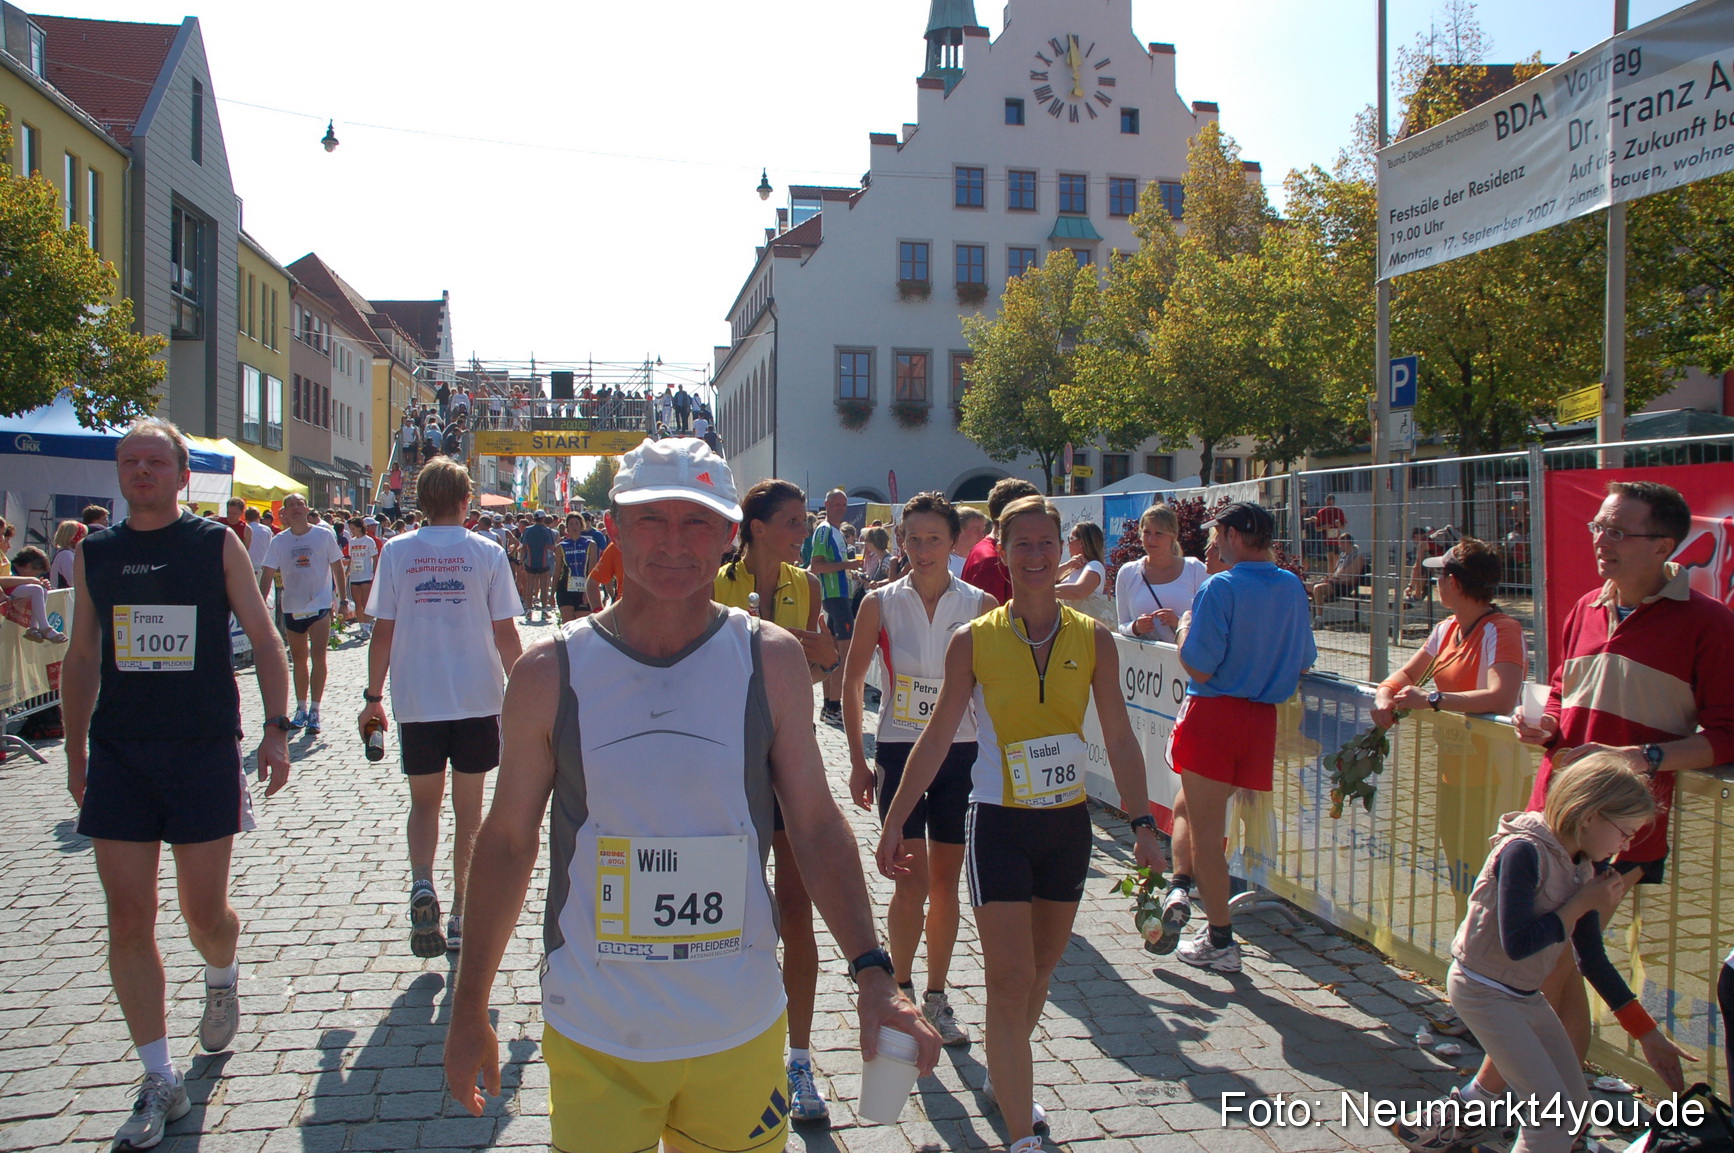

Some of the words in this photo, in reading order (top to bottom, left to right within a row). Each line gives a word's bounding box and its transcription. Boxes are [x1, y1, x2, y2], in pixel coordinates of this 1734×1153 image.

[1035, 51, 1053, 67] X
[1094, 58, 1111, 70] II
[1564, 46, 1642, 97] Vortrag
[1085, 102, 1098, 119] V
[1568, 117, 1599, 152] Dr.
[1607, 80, 1695, 133] Franz
[1704, 59, 1734, 101] A
[1387, 153, 1406, 169] Bund
[1408, 138, 1444, 162] Deutscher
[1446, 119, 1489, 146] Architekten
[1494, 93, 1547, 141] BDA
[1569, 154, 1593, 183] Auf
[1596, 149, 1617, 171] die
[1623, 116, 1707, 160] Zukunft
[1611, 164, 1668, 189] bauen,
[1389, 196, 1439, 224] Festsäle
[1443, 190, 1465, 208] der
[1469, 165, 1525, 198] Residenz
[1391, 227, 1421, 245] 19.00
[1424, 219, 1445, 235] Uhr
[1443, 236, 1457, 251] 17.
[1462, 215, 1524, 245] September
[1526, 199, 1557, 224] 2007
[1391, 364, 1409, 402] P
[532, 435, 591, 450] START
[122, 564, 150, 575] RUN
[134, 611, 164, 624] Franz
[117, 630, 122, 640] D
[136, 634, 189, 652] 1007
[913, 681, 938, 694] Petra
[1126, 663, 1163, 701] gerd
[897, 693, 902, 702] C
[1029, 741, 1061, 759] Isabel
[1013, 769, 1020, 779] C
[1041, 763, 1076, 787] 788
[637, 849, 678, 872] Willi
[603, 884, 612, 901] B
[653, 891, 723, 927] 548
[598, 942, 653, 956] BOCK
[690, 937, 740, 953] PFLEIDERER
